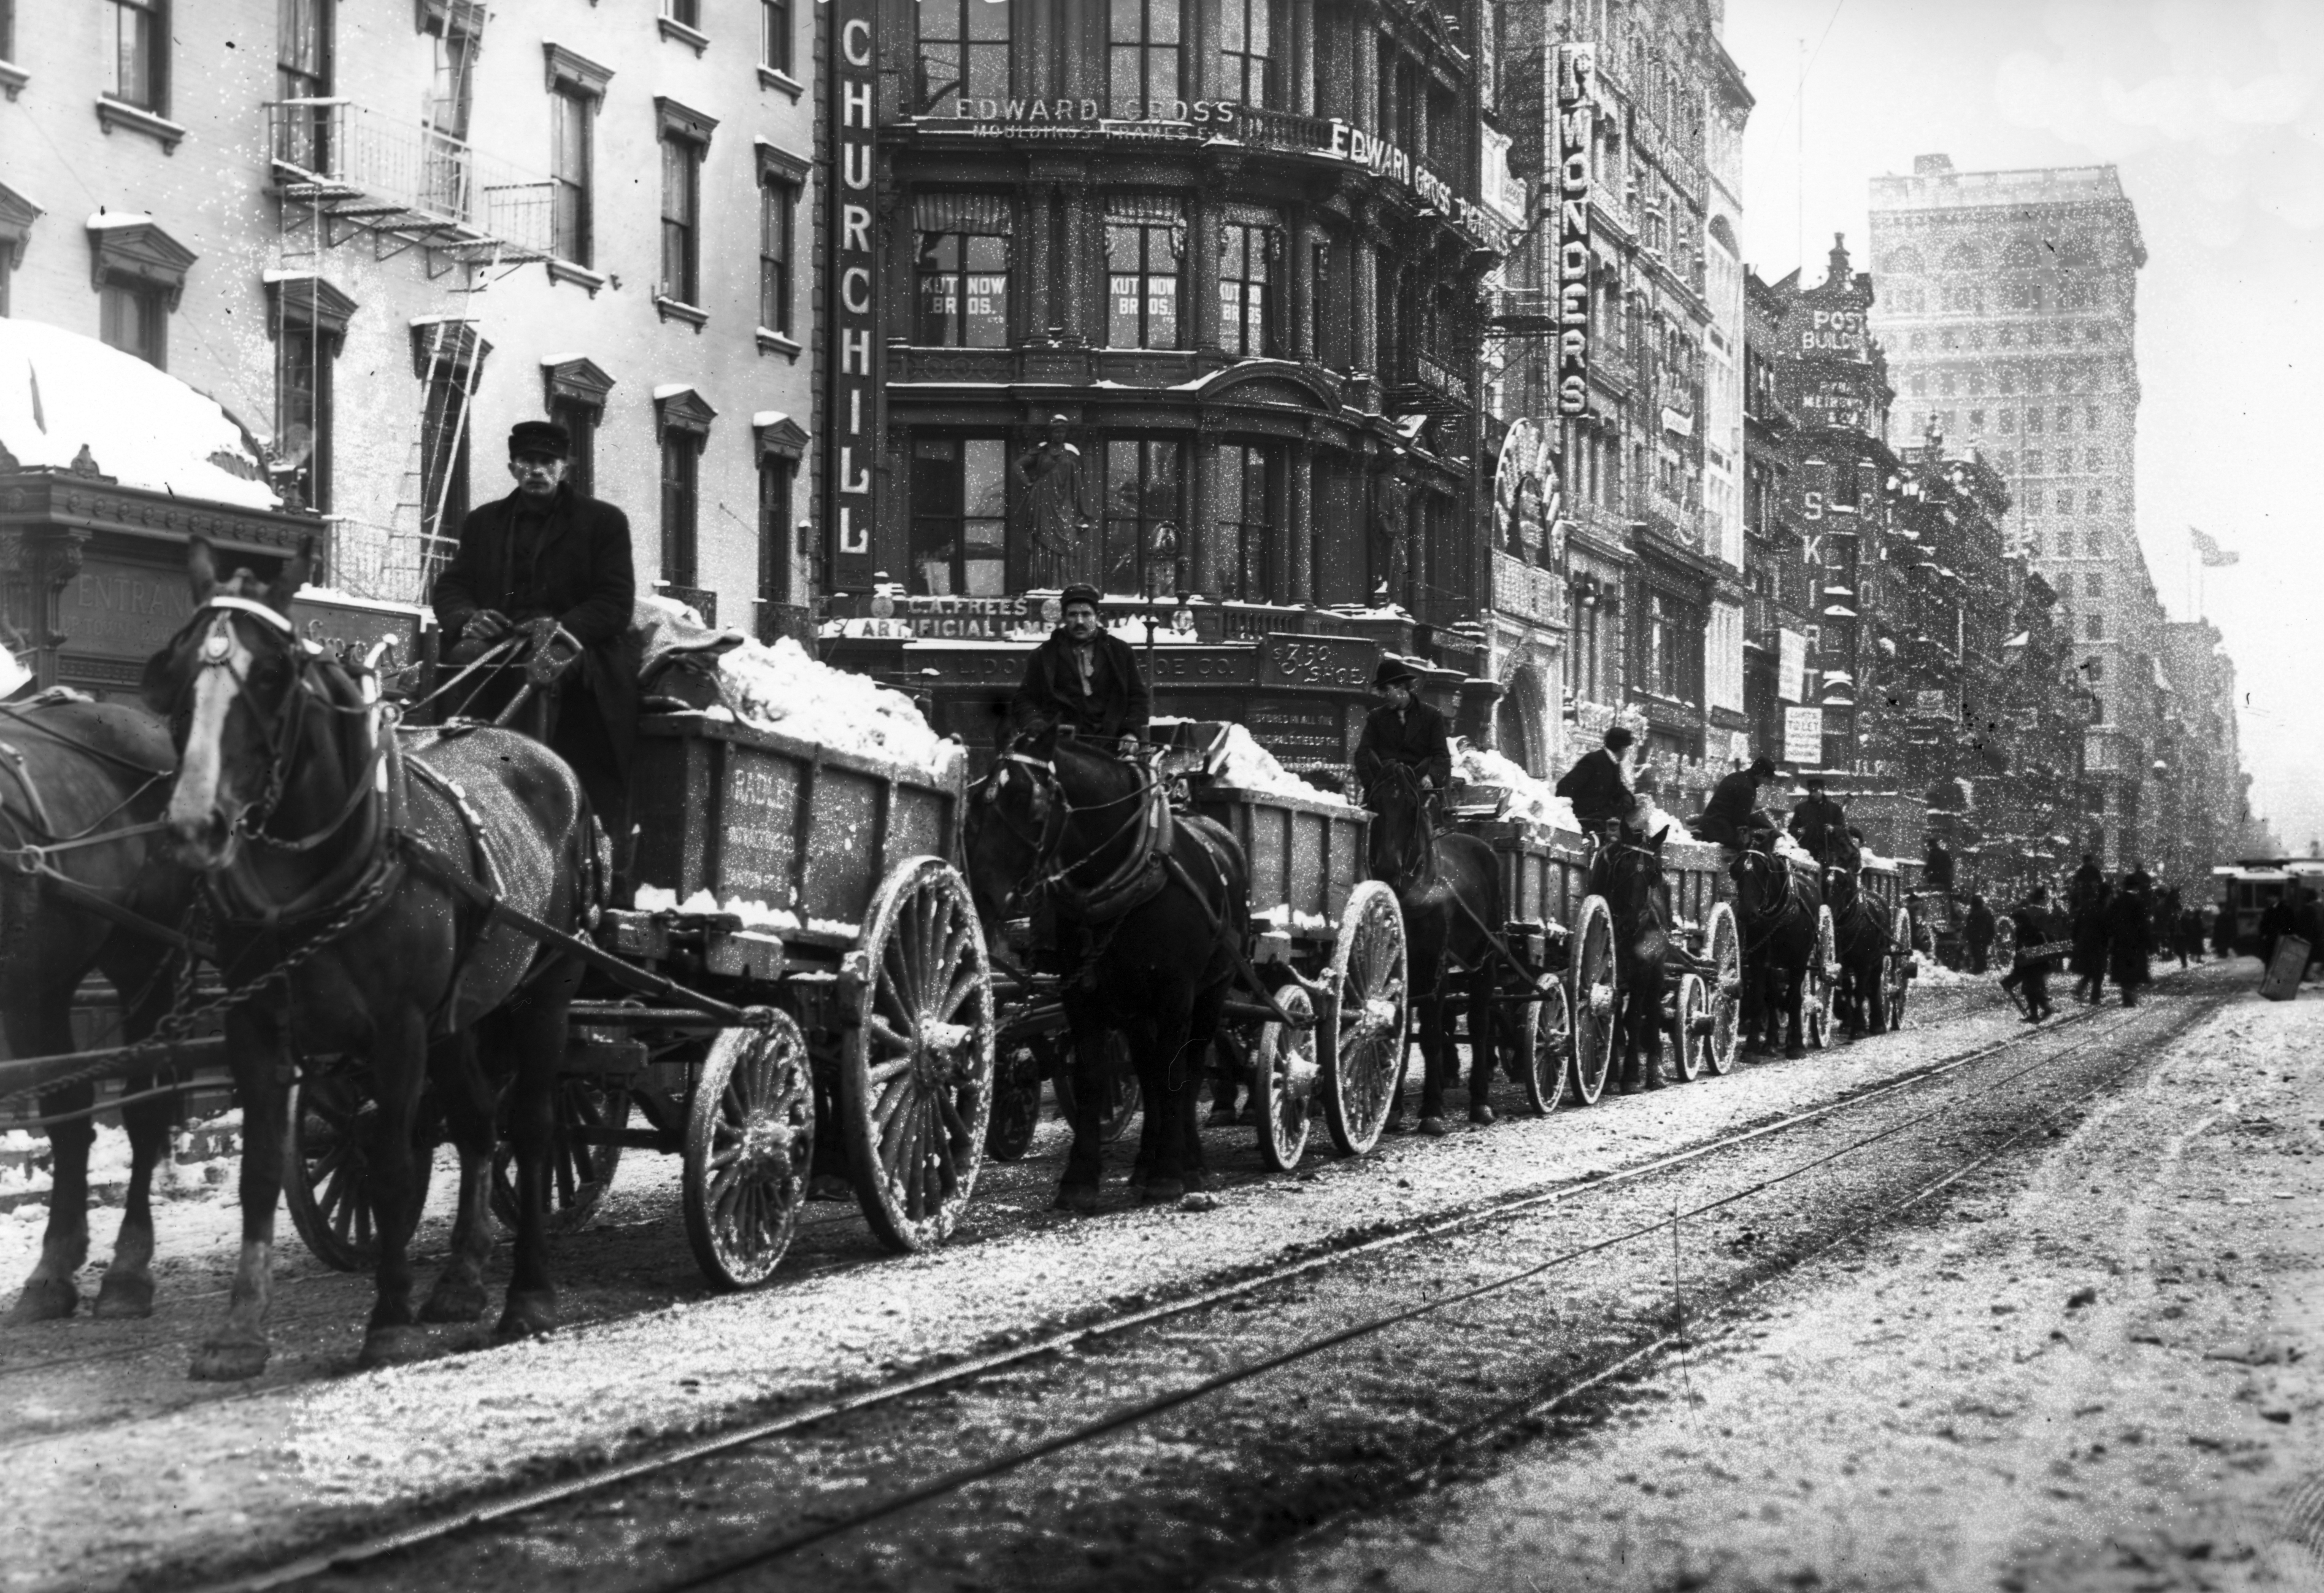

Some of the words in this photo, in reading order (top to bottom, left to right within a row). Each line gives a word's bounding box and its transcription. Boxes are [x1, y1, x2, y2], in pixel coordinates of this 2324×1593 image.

[955, 98, 1098, 121] EDWARD
[973, 124, 1091, 139] MOULDINGS
[1105, 125, 1190, 141] FRAMES
[1559, 109, 1591, 414] WONDERS
[840, 18, 872, 554] CHURCHILL
[79, 573, 193, 617] ENTRAN
[954, 599, 1027, 615] FREES
[862, 619, 996, 638] ARTIFICIAL
[1001, 620, 1057, 638] LIMB
[1199, 657, 1234, 674] CO.
[1304, 666, 1366, 684] SHOE
